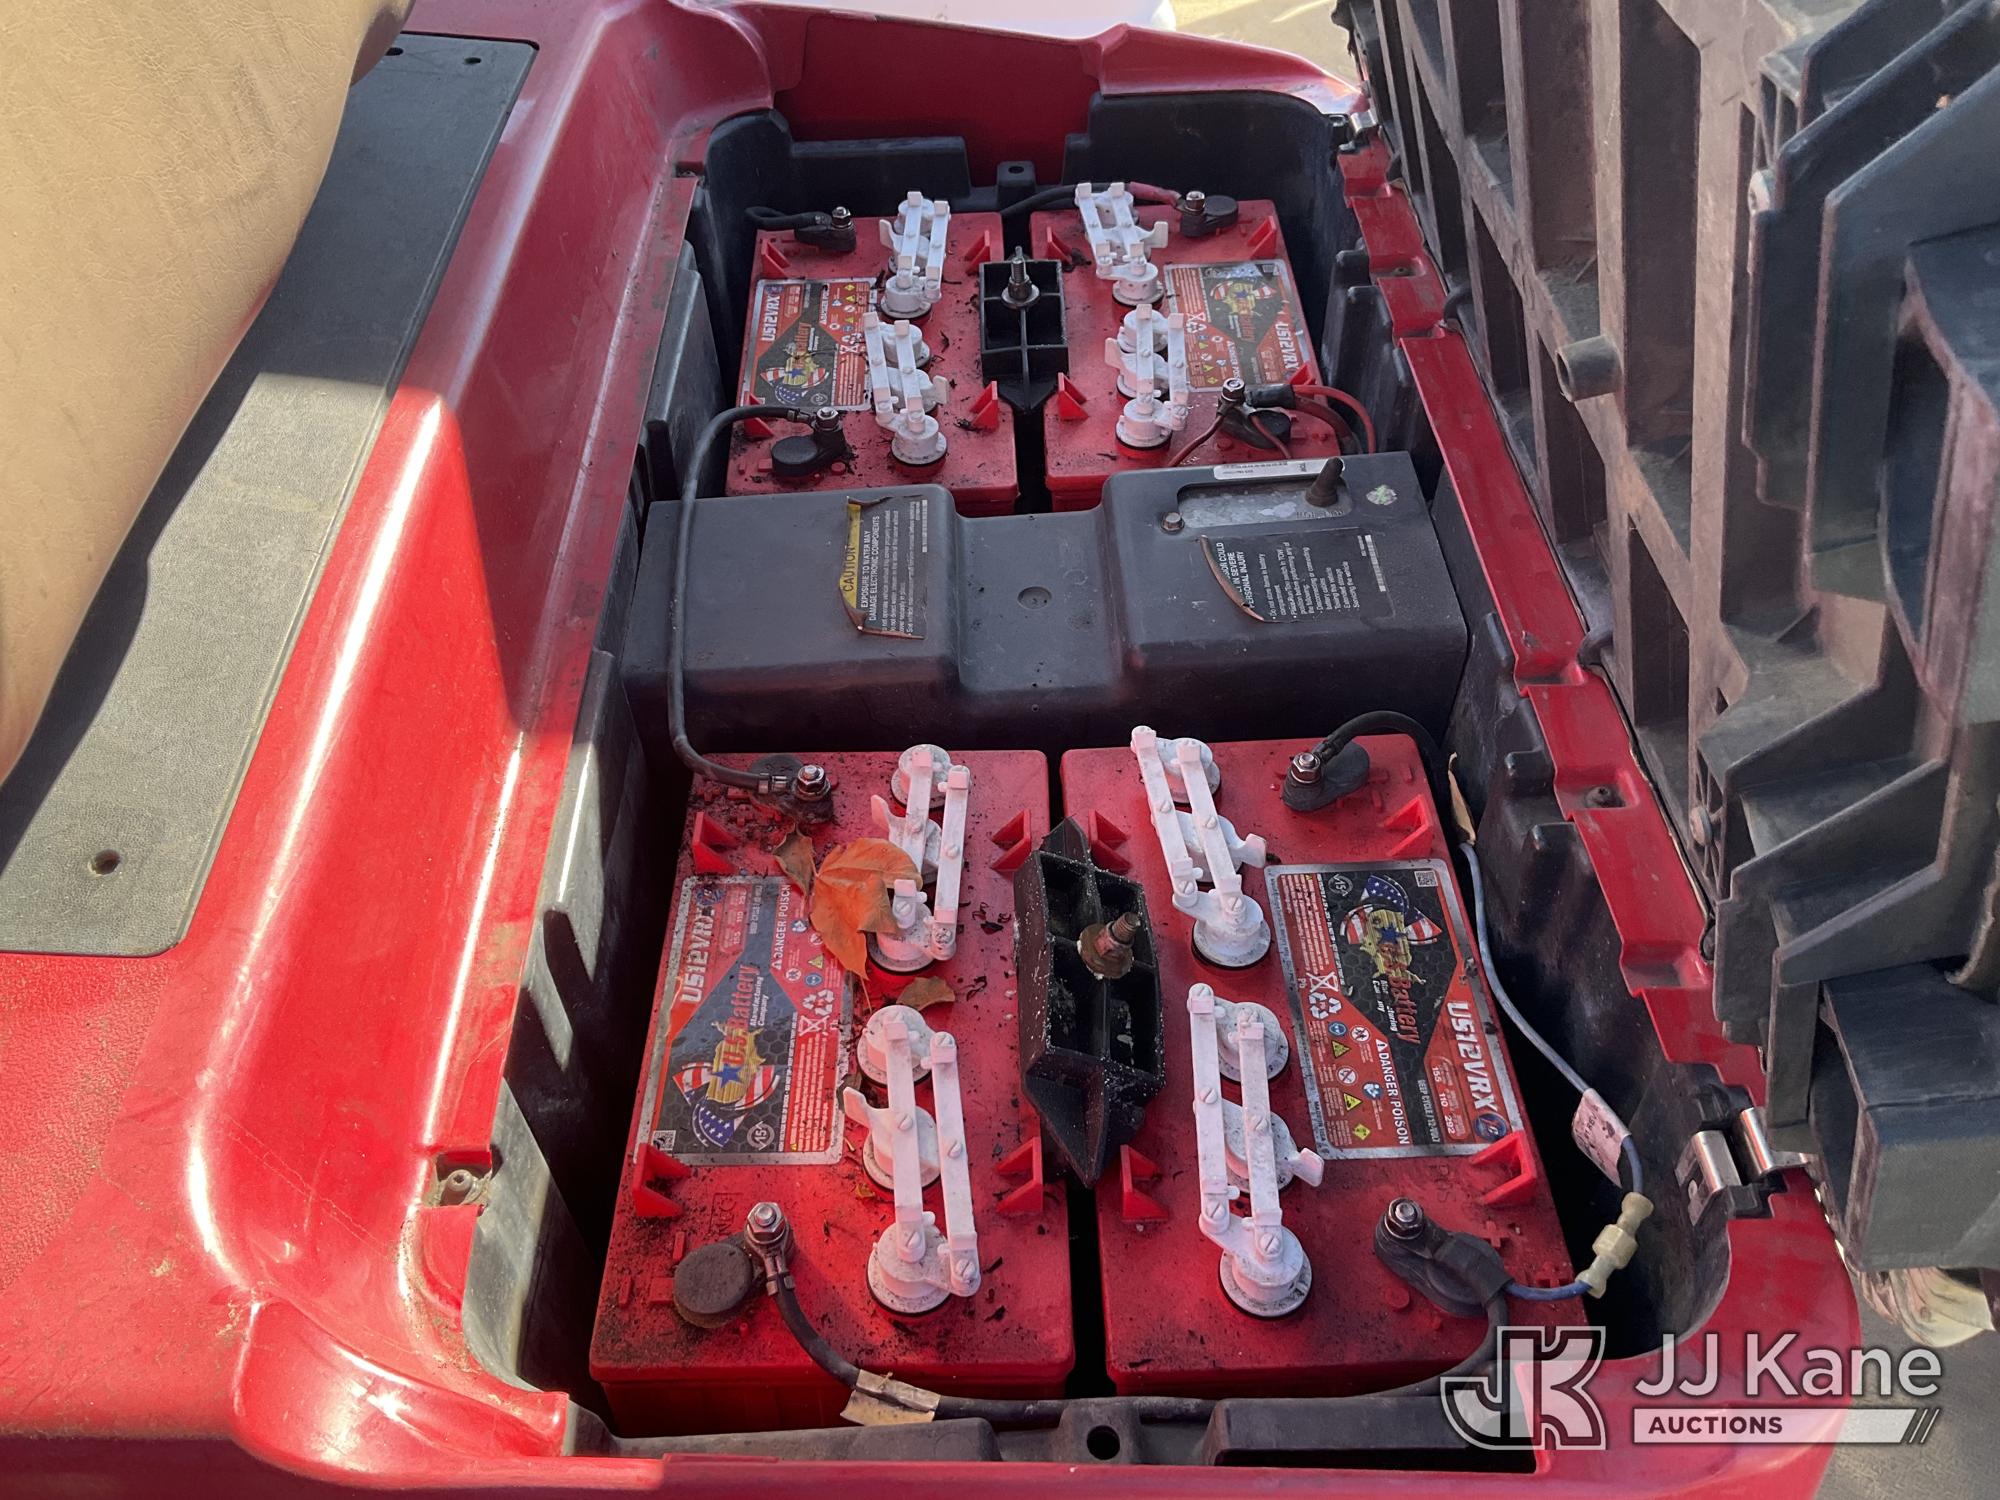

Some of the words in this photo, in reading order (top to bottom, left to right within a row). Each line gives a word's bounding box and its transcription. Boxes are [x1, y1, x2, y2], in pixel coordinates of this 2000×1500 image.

[761, 294, 780, 341] US12VRX
[1275, 323, 1299, 370] US12VRX
[1216, 542, 1227, 561] COULD
[1237, 551, 1247, 573] INJURY
[1259, 554, 1267, 569] battery
[1303, 547, 1313, 571] connecting
[842, 546, 856, 592] CAUTION
[863, 565, 869, 574] TO
[870, 556, 879, 593] ELECTRONIC
[1227, 552, 1239, 576] SEVERE
[1288, 556, 1300, 580] performing
[1326, 567, 1335, 583] vehicle
[1343, 561, 1351, 577] vehicle
[1294, 581, 1302, 595] before
[1320, 578, 1328, 593] cables
[1336, 569, 1344, 586] storage
[861, 575, 870, 607] EXPOSURE
[1241, 574, 1255, 608] PERSONAL
[1311, 578, 1323, 610] Disconnecting
[1324, 594, 1332, 609] battery
[1333, 593, 1341, 609] Towing
[1339, 586, 1350, 608] Extended
[1349, 586, 1360, 607] Servicing
[869, 594, 877, 620] DAMAGE
[1297, 596, 1307, 614] position
[1335, 880, 1346, 889] 15
[777, 884, 791, 917] POISON
[773, 920, 788, 958] DANGER
[1298, 978, 1307, 988] Pb
[726, 964, 760, 1029] Battery
[750, 976, 764, 1027] Manufacturing
[758, 993, 769, 1027] Company
[1386, 976, 1422, 1044] Battery
[1446, 1001, 1498, 1112] US12VRX
[1378, 1052, 1402, 1097] DANGER
[1391, 1101, 1409, 1144] POISON
[1418, 1079, 1428, 1094] DEEP
[1422, 1096, 1433, 1113] CYCLE
[1432, 1066, 1442, 1082] 155
[1439, 1093, 1448, 1107] 110
[1445, 1115, 1455, 1134] 292
[756, 1128, 767, 1140] 15
[1428, 1119, 1440, 1142] 12-VOLT
